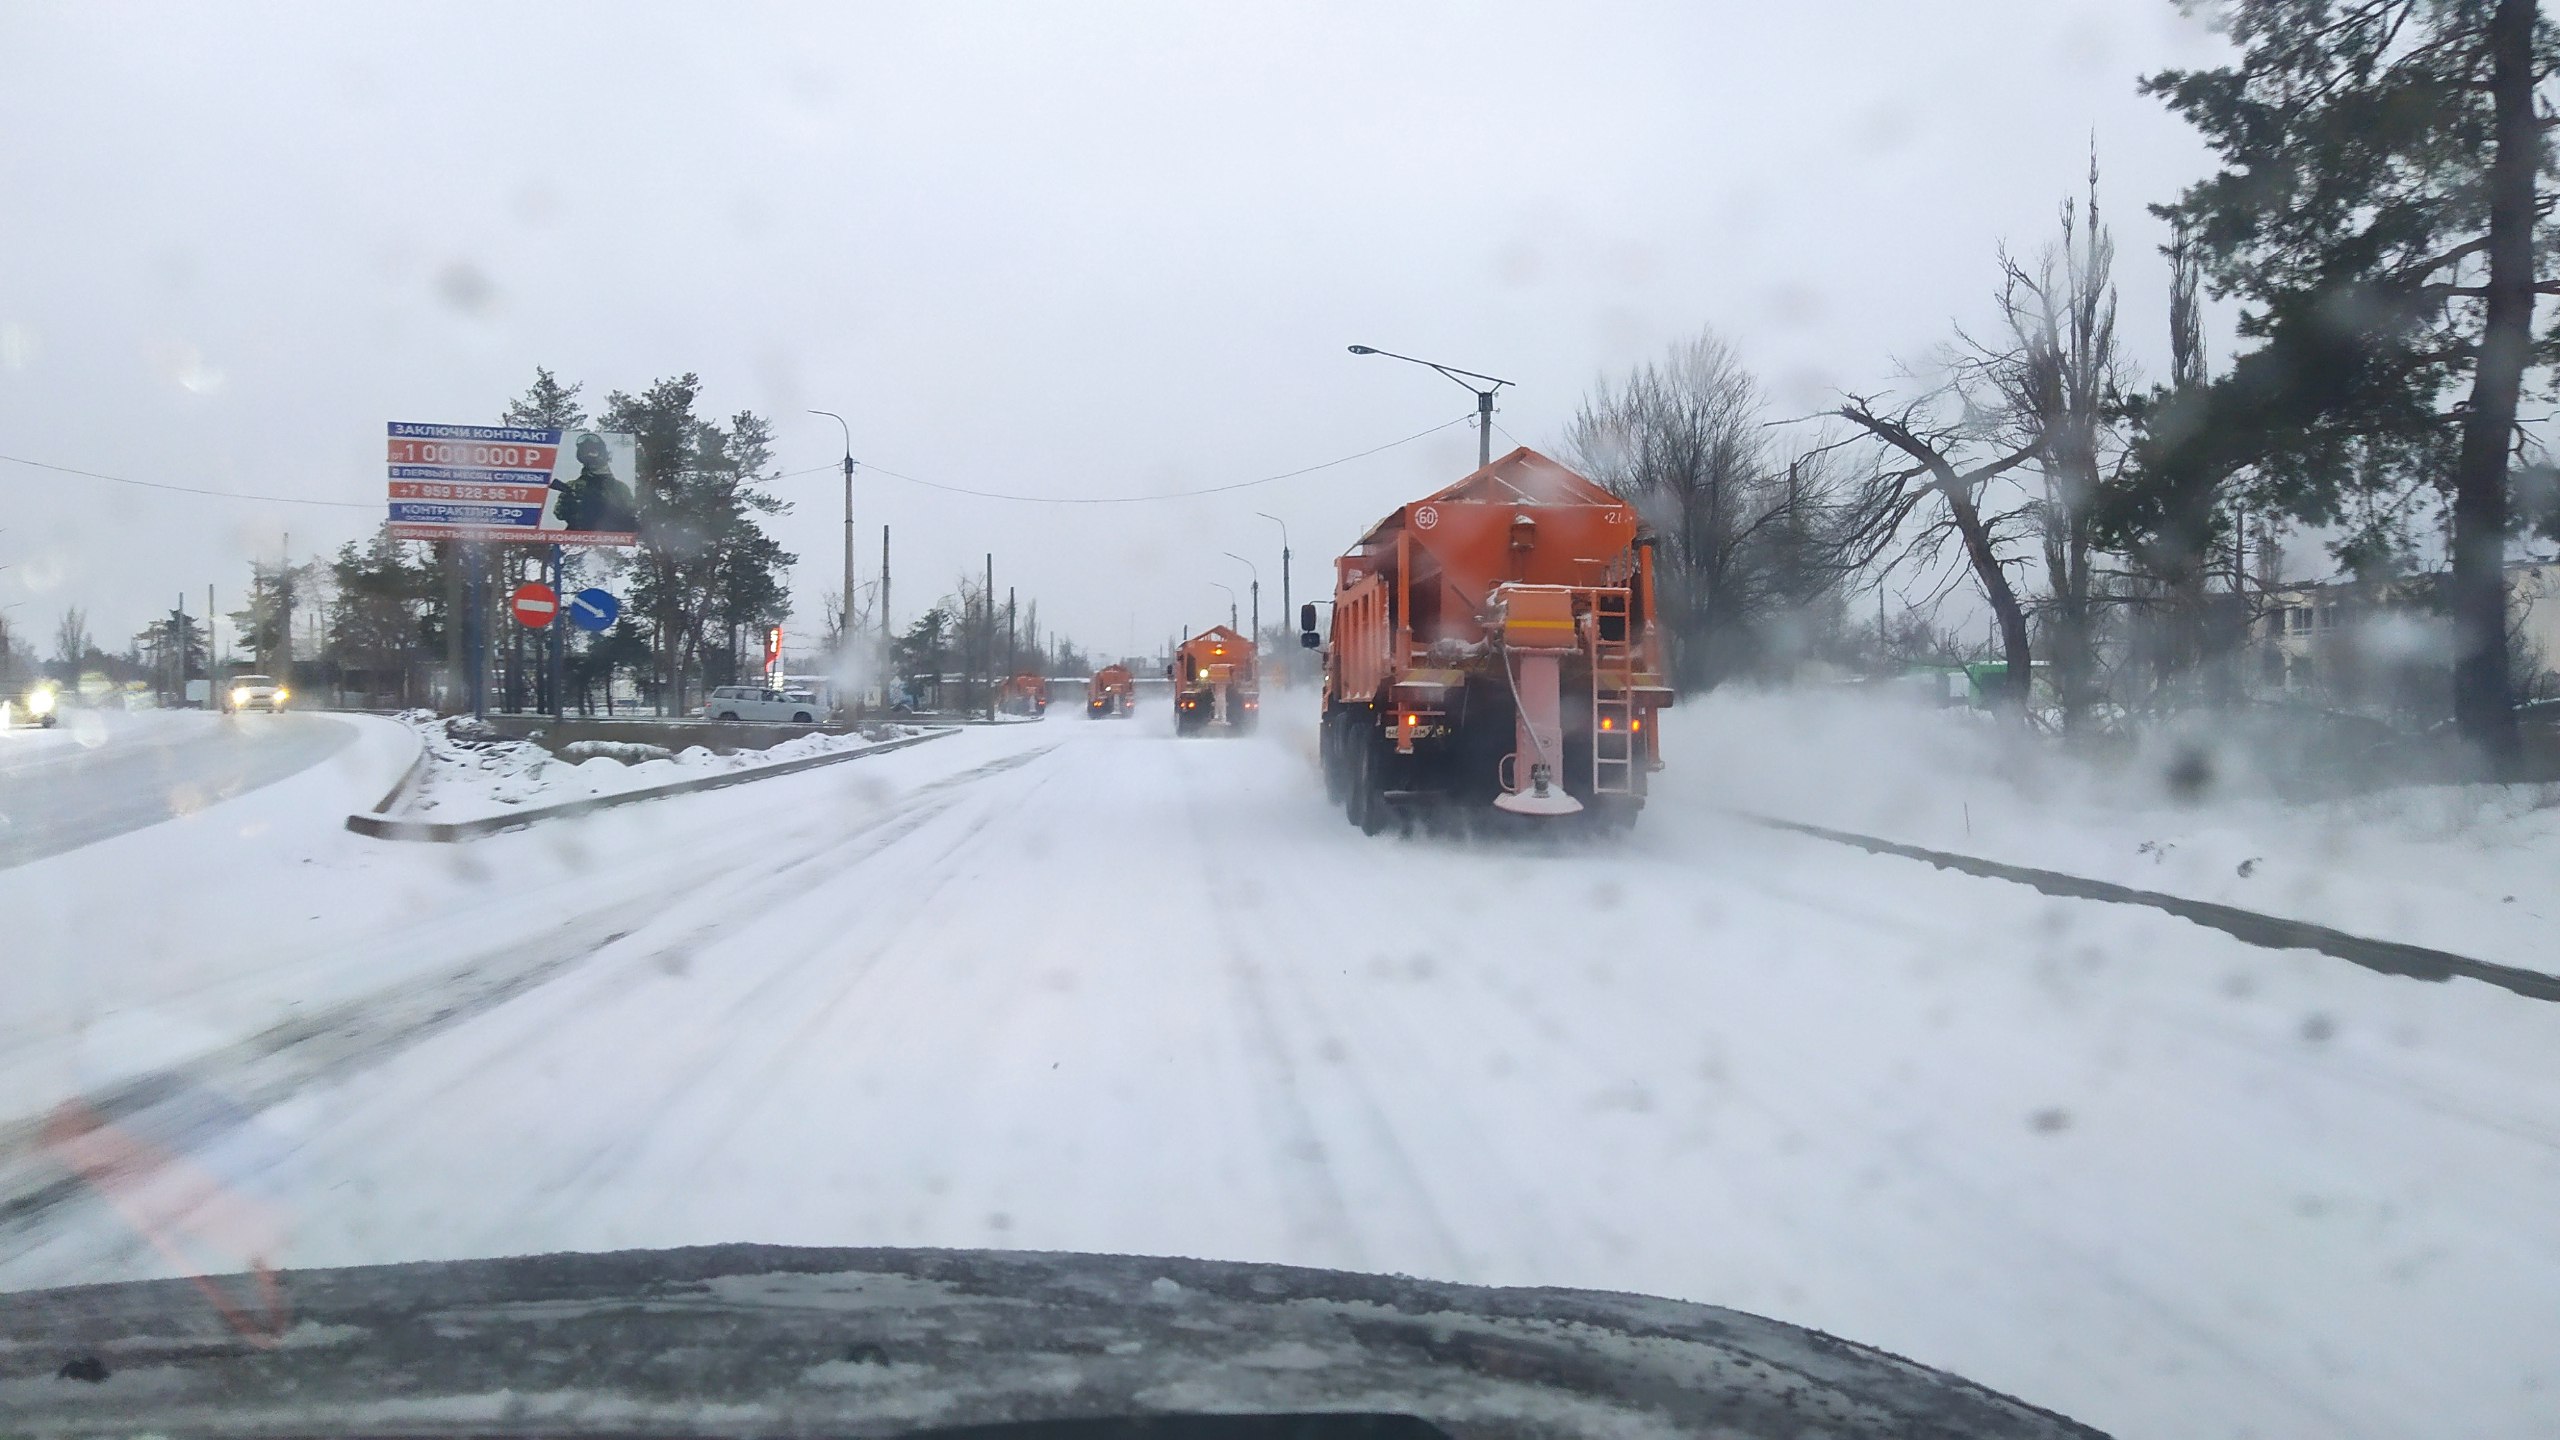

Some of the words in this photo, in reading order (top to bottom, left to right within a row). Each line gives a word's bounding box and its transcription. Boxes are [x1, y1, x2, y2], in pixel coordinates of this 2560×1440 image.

[396, 424, 470, 438] ЗАКЛЮЧИ
[473, 428, 548, 441] КОНТРАКТ
[406, 444, 414, 461] 1
[422, 445, 467, 464] 000
[474, 447, 519, 466] 000
[392, 468, 399, 476] В
[402, 468, 451, 478] ПЕРВЫЙ
[494, 472, 544, 482] СЛУЖБЫ
[400, 486, 418, 496] +7
[422, 486, 450, 497] 959
[1419, 511, 1434, 524] 60
[393, 529, 474, 540] ОБРАЩАТЬСЯ
[488, 531, 546, 542] ВОЕННЫЙ
[549, 534, 634, 544] КОМИССАРИАТ
